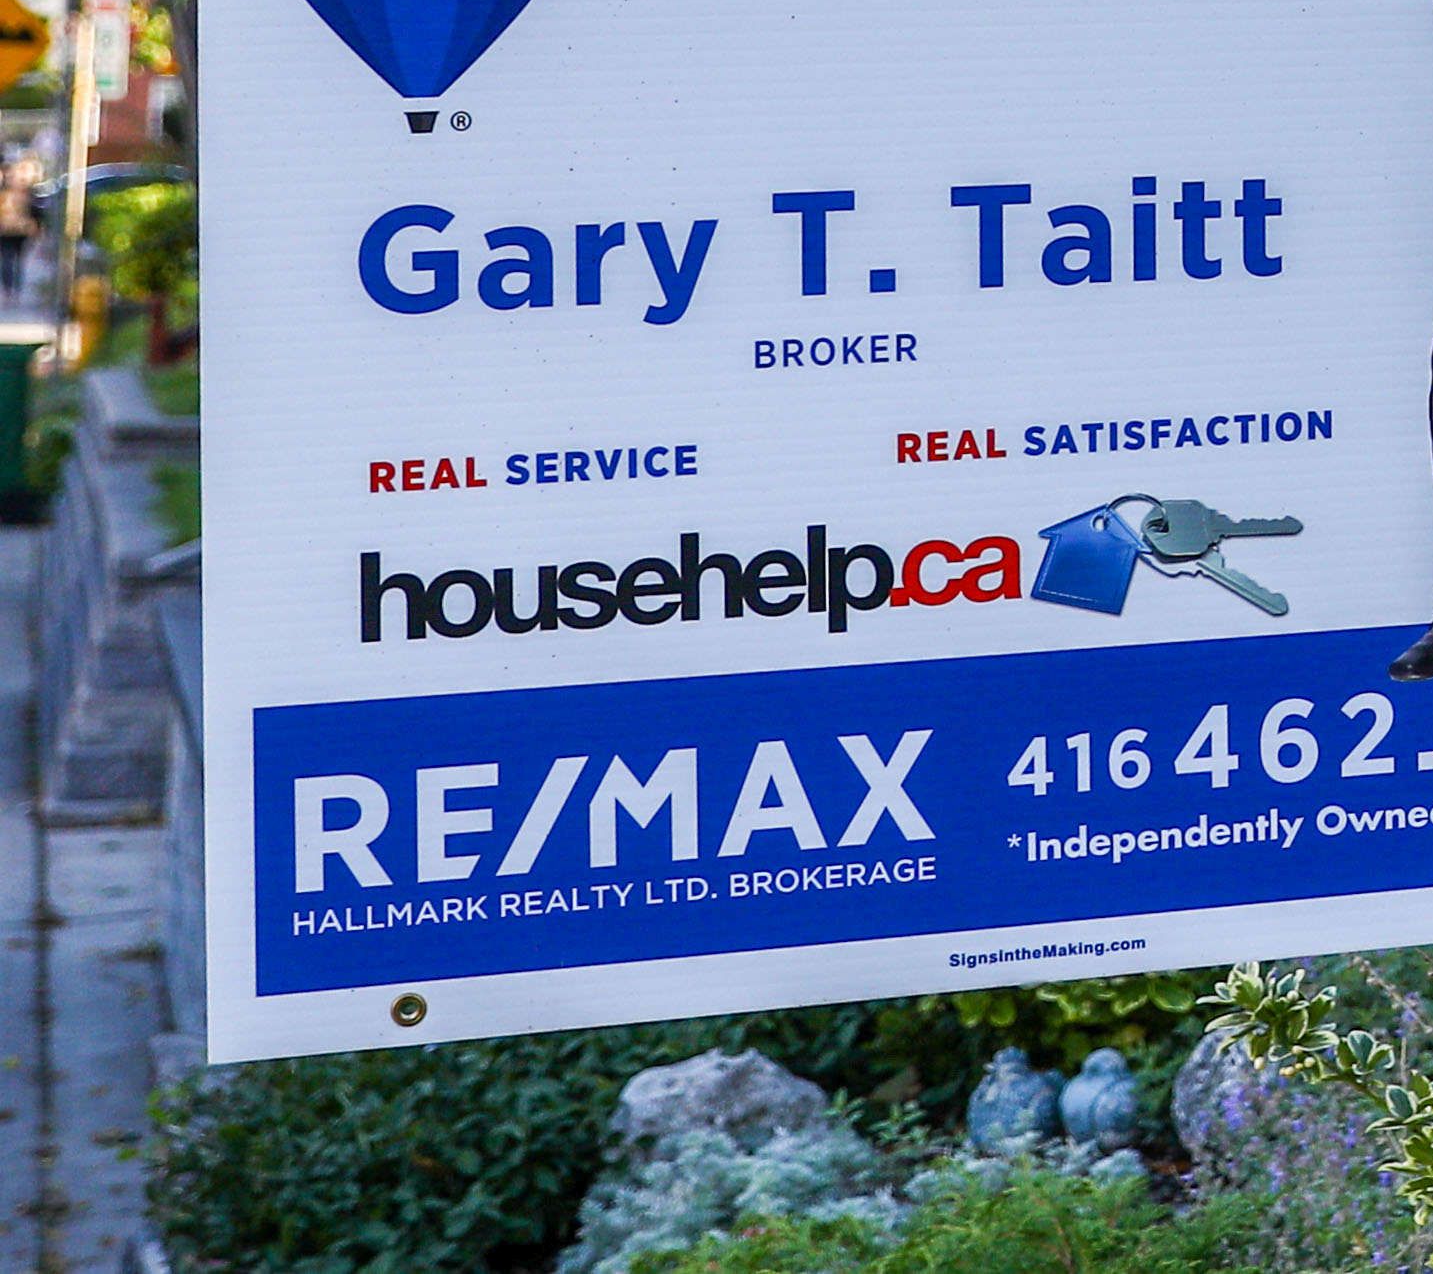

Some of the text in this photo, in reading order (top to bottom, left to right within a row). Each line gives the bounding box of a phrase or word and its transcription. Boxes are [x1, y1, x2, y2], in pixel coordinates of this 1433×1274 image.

[358, 175, 1283, 326] Gary T. Taitt
[754, 333, 918, 369] BROKER
[369, 444, 698, 494] REAL SERVICE
[897, 409, 1333, 464] REAL SATISFACTION
[360, 524, 1022, 643] househelp.ca
[1007, 728, 1151, 796] 416
[294, 729, 937, 894] RE/MAX
[293, 856, 937, 936] HALLMARK REALTY LTD. BROKERAGE
